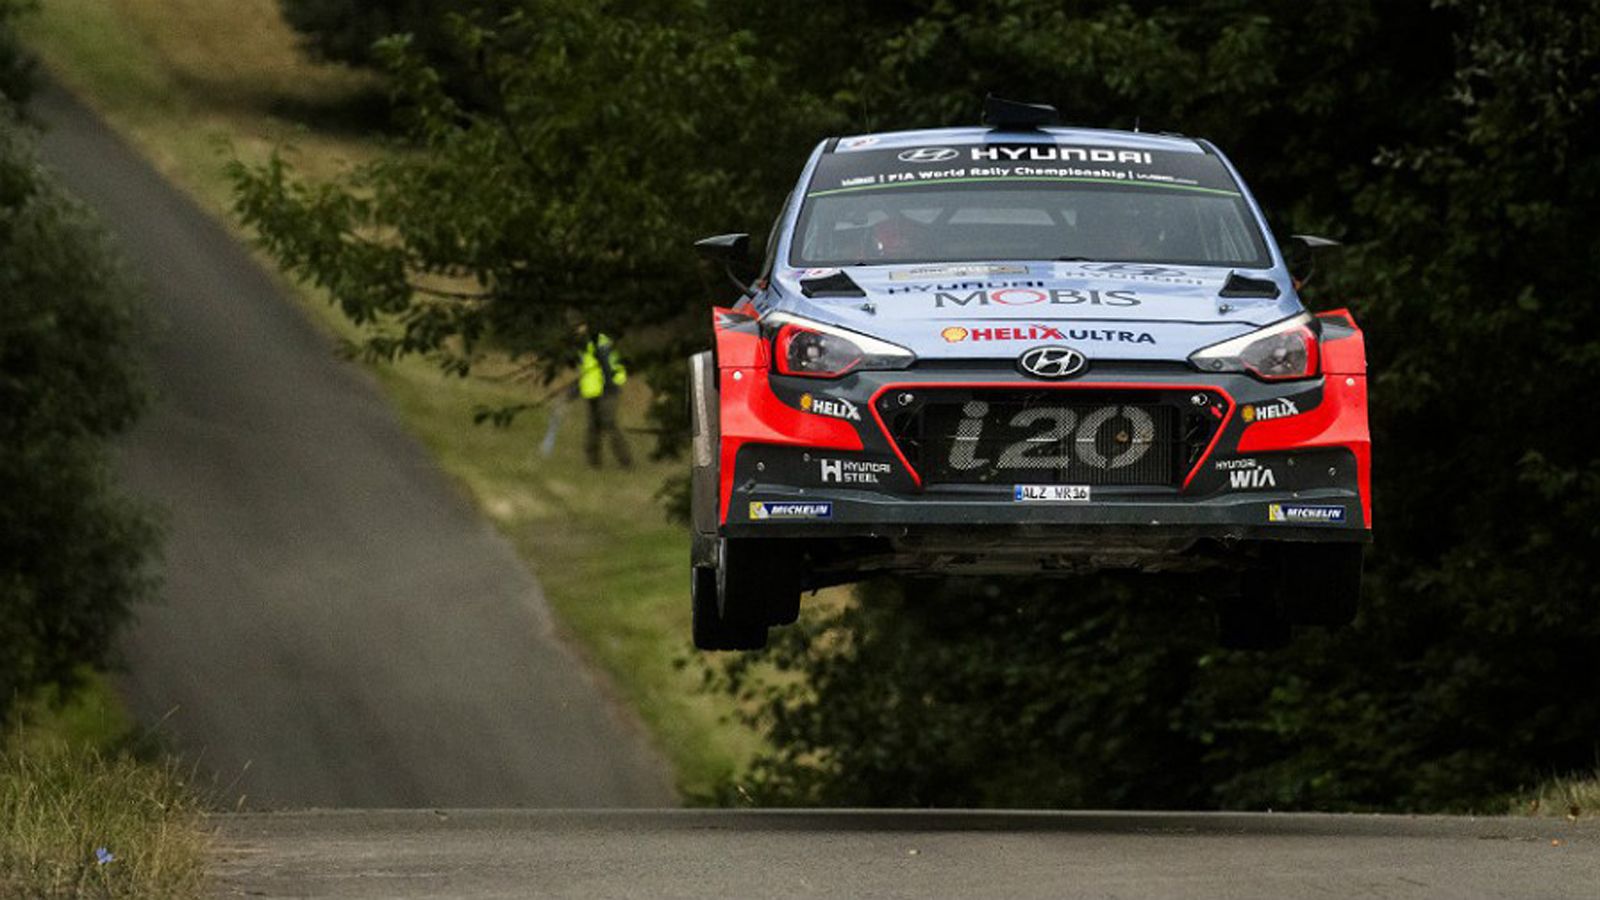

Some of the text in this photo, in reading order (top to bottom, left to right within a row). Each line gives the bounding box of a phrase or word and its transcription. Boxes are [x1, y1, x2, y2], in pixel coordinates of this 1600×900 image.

[970, 147, 1153, 164] HYUNDAI
[888, 171, 915, 182] FIA
[918, 168, 965, 178] World
[970, 167, 1010, 177] Rally
[1014, 166, 1127, 179] Championship
[888, 281, 1045, 294] HYUNDAI
[934, 289, 1142, 307] MOBIS
[971, 324, 1156, 344] HELIX ULTRA
[812, 397, 862, 421] HELIX
[1256, 397, 1299, 420] HELIX
[948, 400, 1154, 471] i20
[843, 462, 891, 473] HYUNDAI
[1215, 458, 1257, 470] HYUNDAI
[843, 473, 879, 483] STEEL
[1023, 487, 1047, 499] ALZ
[770, 503, 828, 515] MICHELIN
[1286, 507, 1342, 518] MICHELIN
